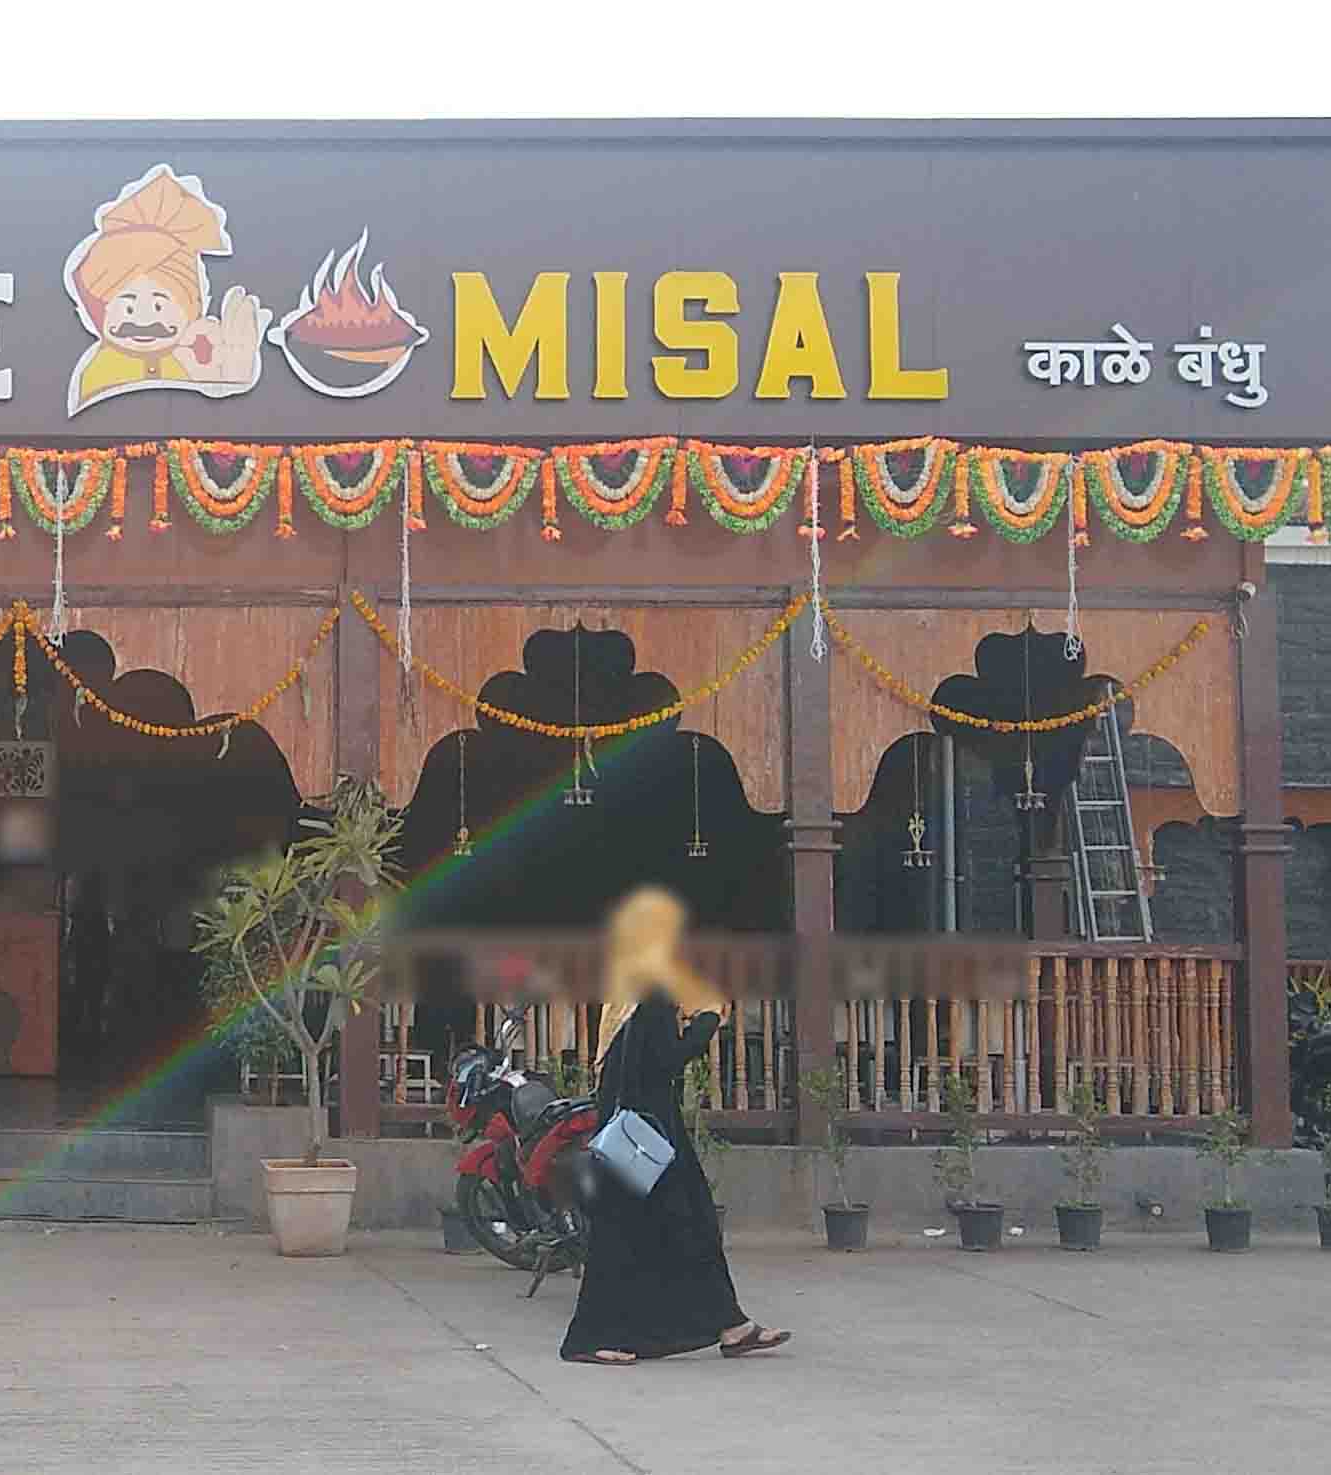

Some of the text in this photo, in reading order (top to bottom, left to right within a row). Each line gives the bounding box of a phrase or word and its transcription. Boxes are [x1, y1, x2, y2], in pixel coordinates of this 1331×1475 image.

[449, 270, 952, 402] MISAL
[1023, 322, 1270, 409] काळे बंधु
